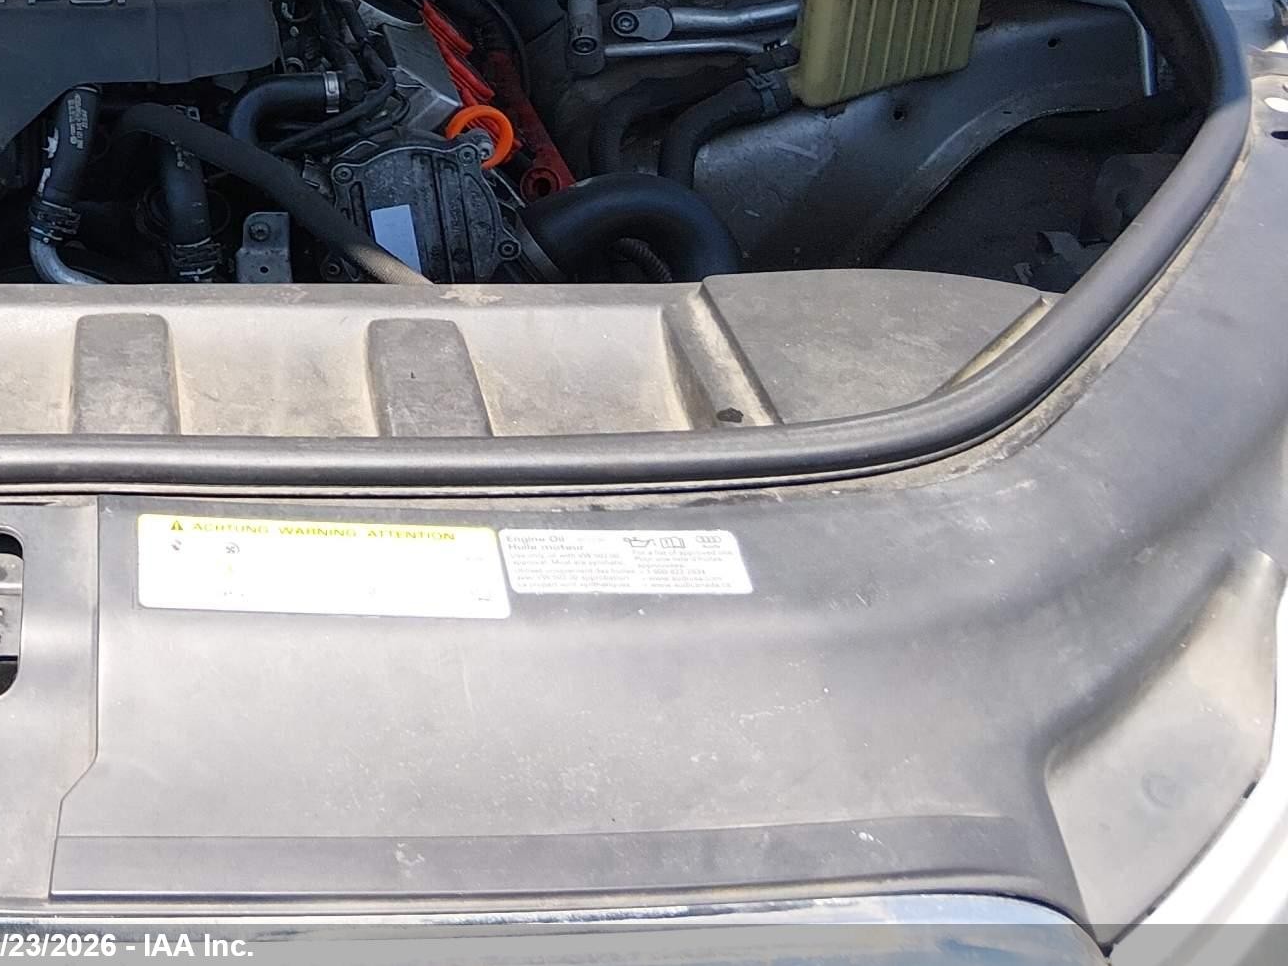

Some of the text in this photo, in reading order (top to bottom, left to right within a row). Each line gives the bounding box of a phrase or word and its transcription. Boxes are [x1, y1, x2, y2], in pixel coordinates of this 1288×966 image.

[192, 522, 456, 541] ACHTUNG WARNING ATTENTION
[506, 535, 546, 545] Engine
